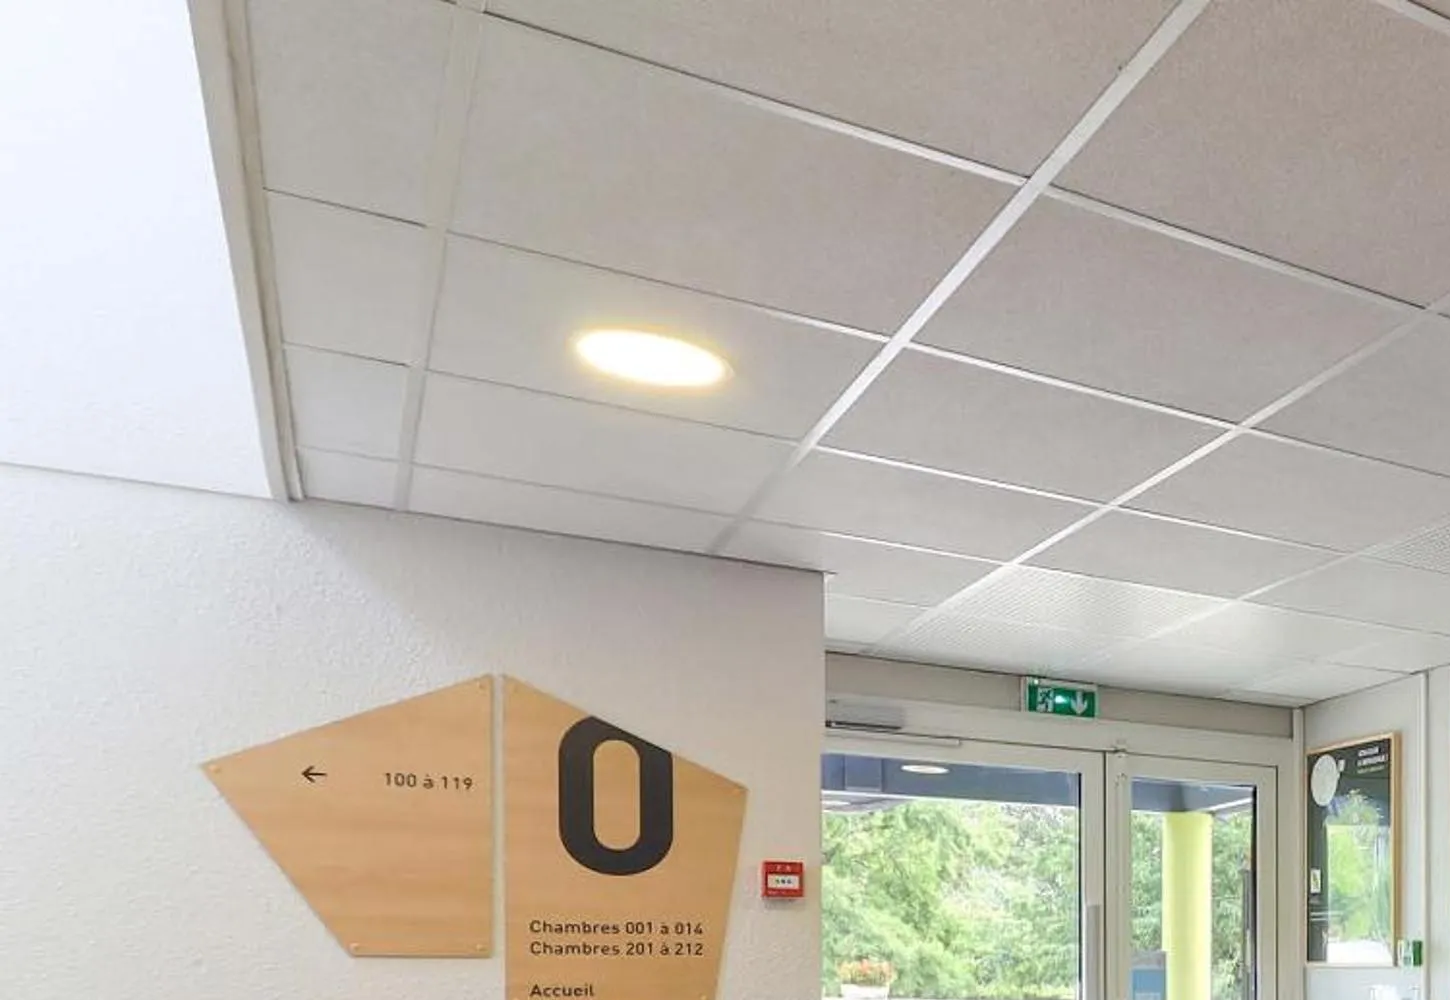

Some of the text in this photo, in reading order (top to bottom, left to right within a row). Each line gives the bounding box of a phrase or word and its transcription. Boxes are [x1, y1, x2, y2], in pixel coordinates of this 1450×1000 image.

[385, 772, 473, 790] 100 à 119
[529, 920, 704, 935] Chambres 001 à 014
[530, 941, 704, 956] Chambres 201 à 212
[529, 983, 595, 997] Accueil
